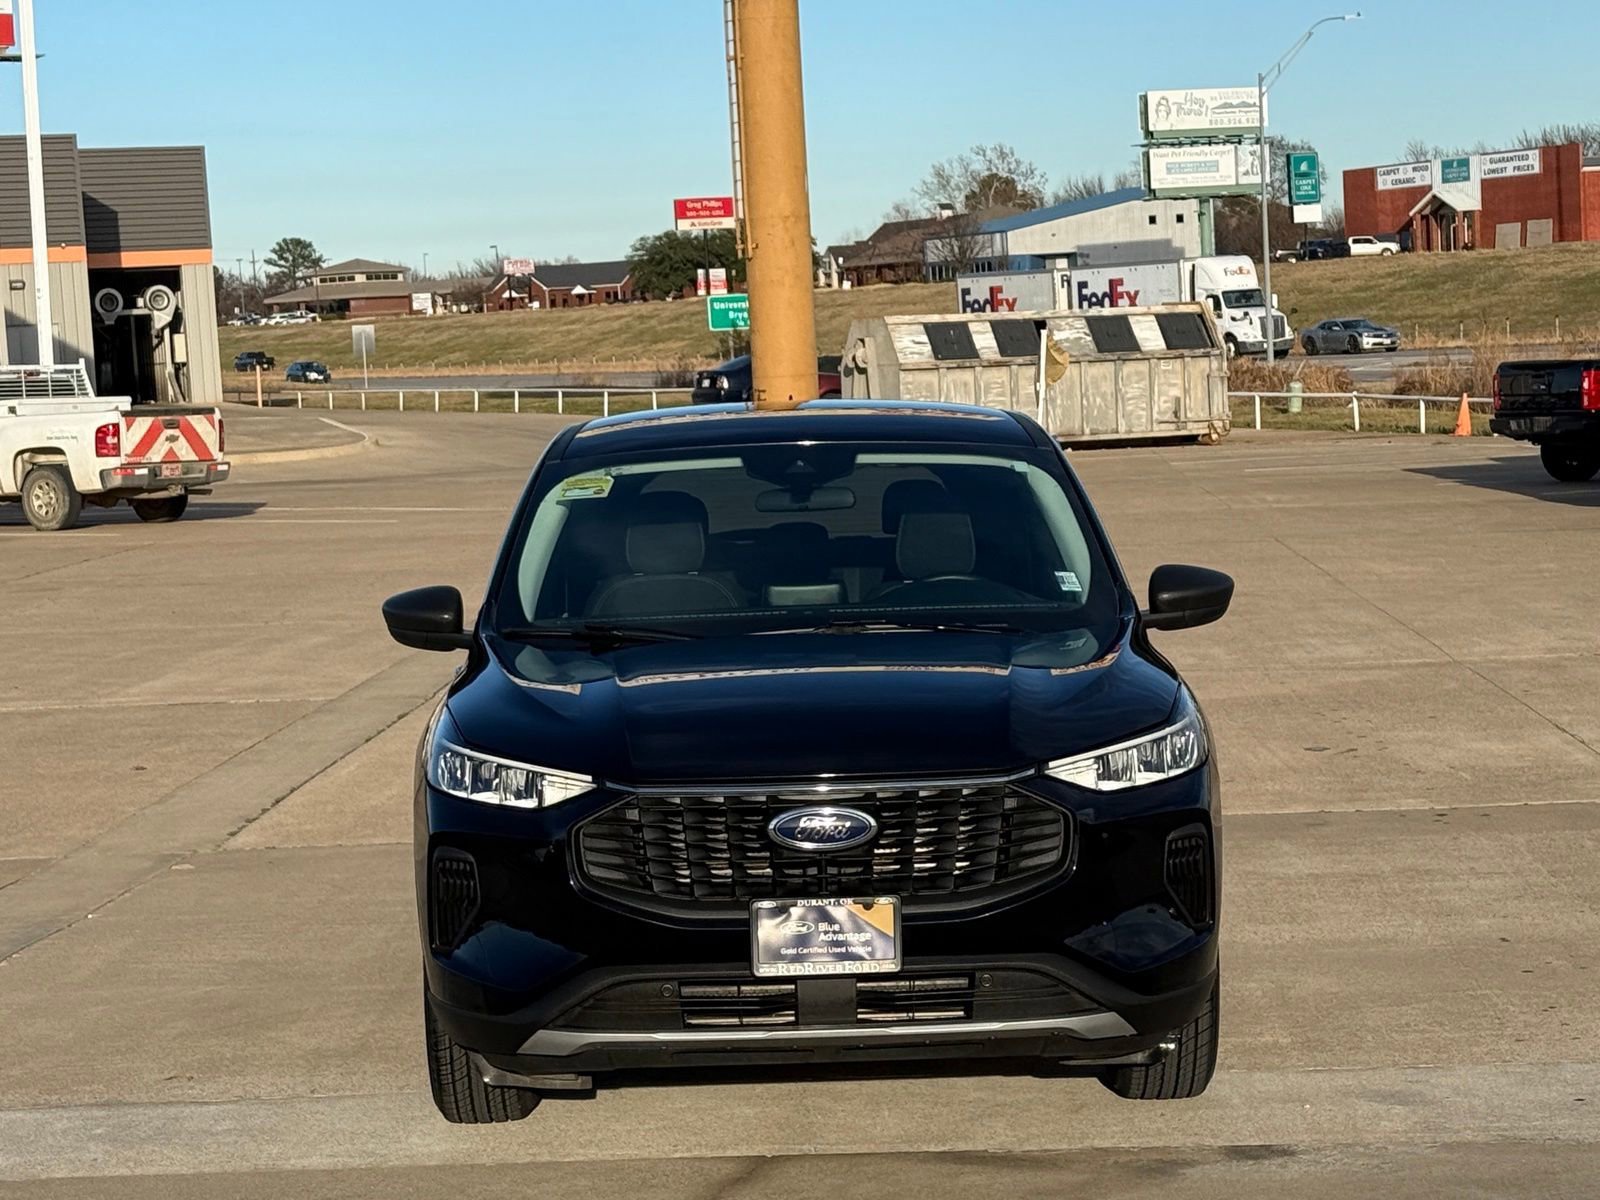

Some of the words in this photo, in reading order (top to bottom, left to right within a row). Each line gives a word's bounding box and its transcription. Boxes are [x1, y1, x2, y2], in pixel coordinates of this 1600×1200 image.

[1183, 149, 1208, 157] Friendly
[1489, 153, 1530, 165] GUARANTEED
[1378, 167, 1400, 177] CARPET
[1411, 164, 1429, 173] WOOD
[1483, 166, 1508, 176] LOWEST
[1512, 164, 1535, 173] PRICES
[1391, 176, 1417, 186] CERAMIC
[1224, 266, 1251, 277] FedEx
[795, 816, 852, 840] Ford
[840, 897, 854, 906] OK
[818, 922, 841, 931] Blue
[818, 931, 872, 942] Advantage
[780, 946, 798, 955] Gold
[798, 945, 828, 954] Certified
[828, 945, 847, 954] Used
[847, 944, 872, 953] Vehicle
